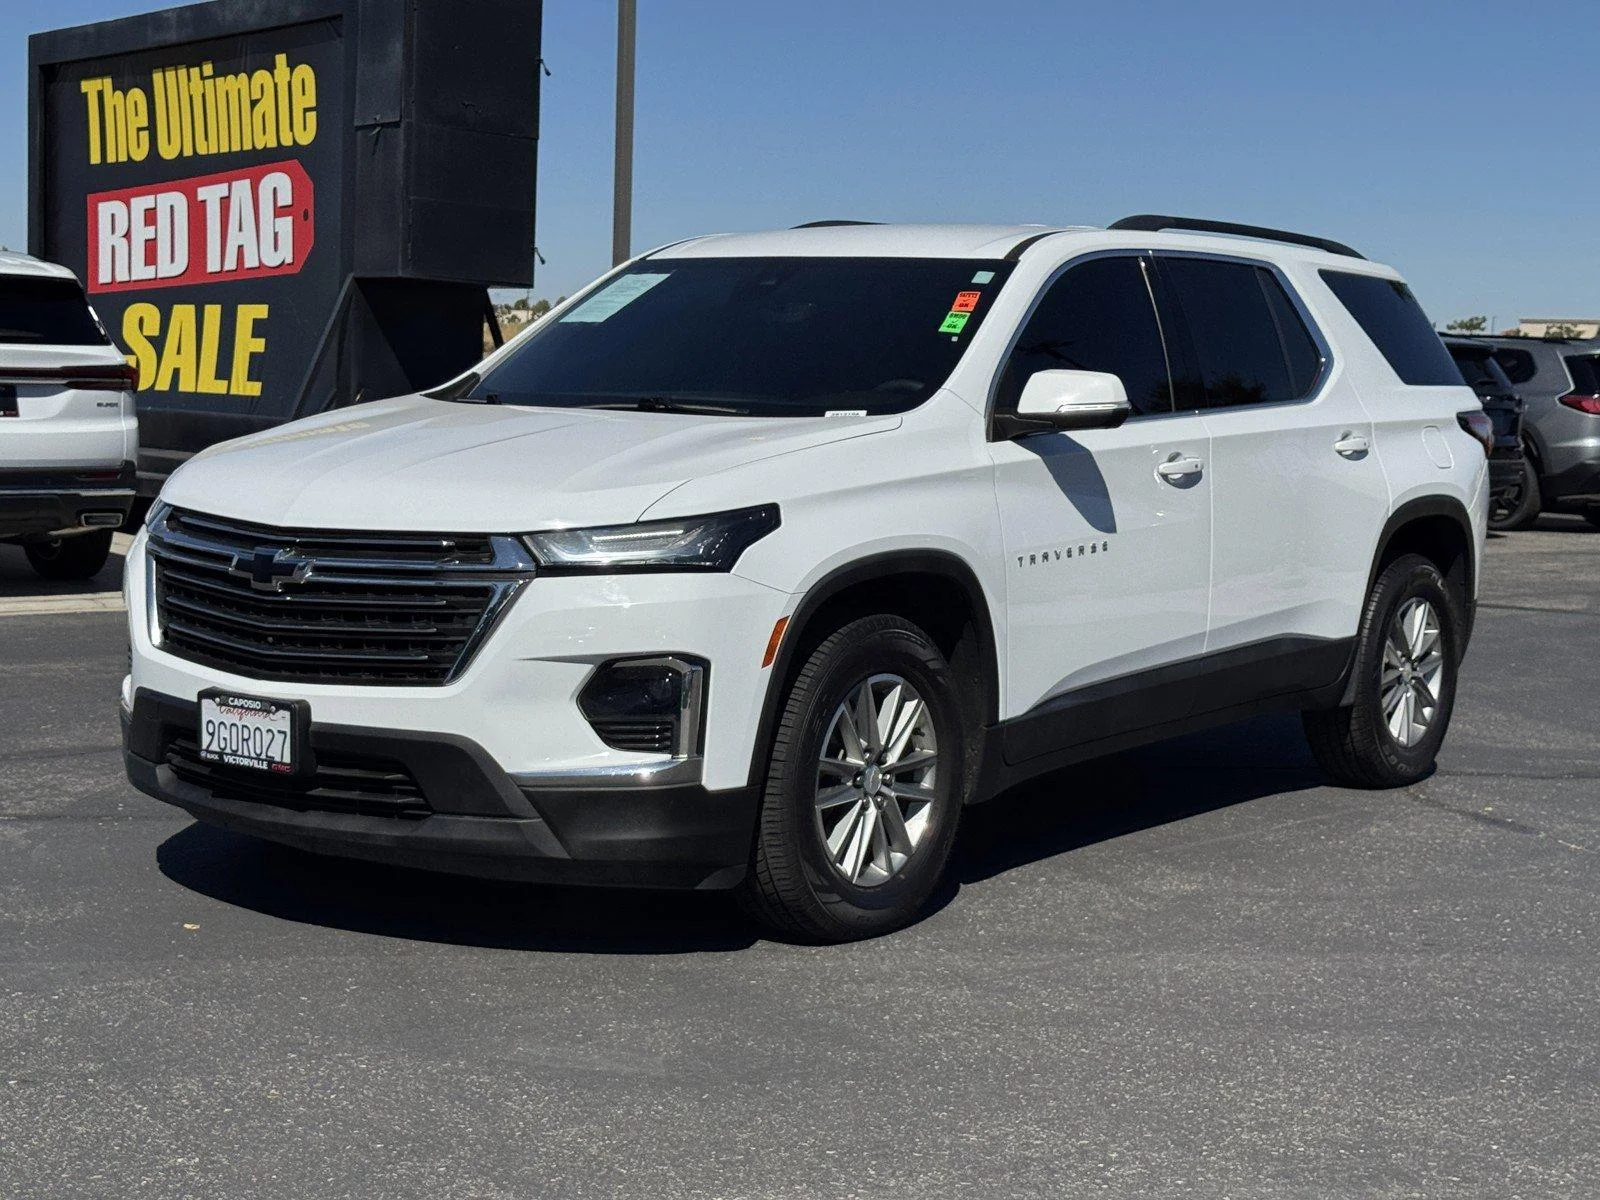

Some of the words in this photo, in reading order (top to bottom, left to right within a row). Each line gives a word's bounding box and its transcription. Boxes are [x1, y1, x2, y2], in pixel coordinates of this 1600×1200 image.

[80, 76, 150, 165] The
[152, 53, 317, 160] Ultimate
[97, 191, 189, 285] RED
[197, 171, 294, 274] TAG
[122, 302, 269, 397] SALE
[1017, 540, 1108, 568] TRAVERSE
[228, 697, 262, 709] CAPOSIO
[223, 754, 269, 770] VICTORVILLE
[271, 763, 292, 773] GMC
